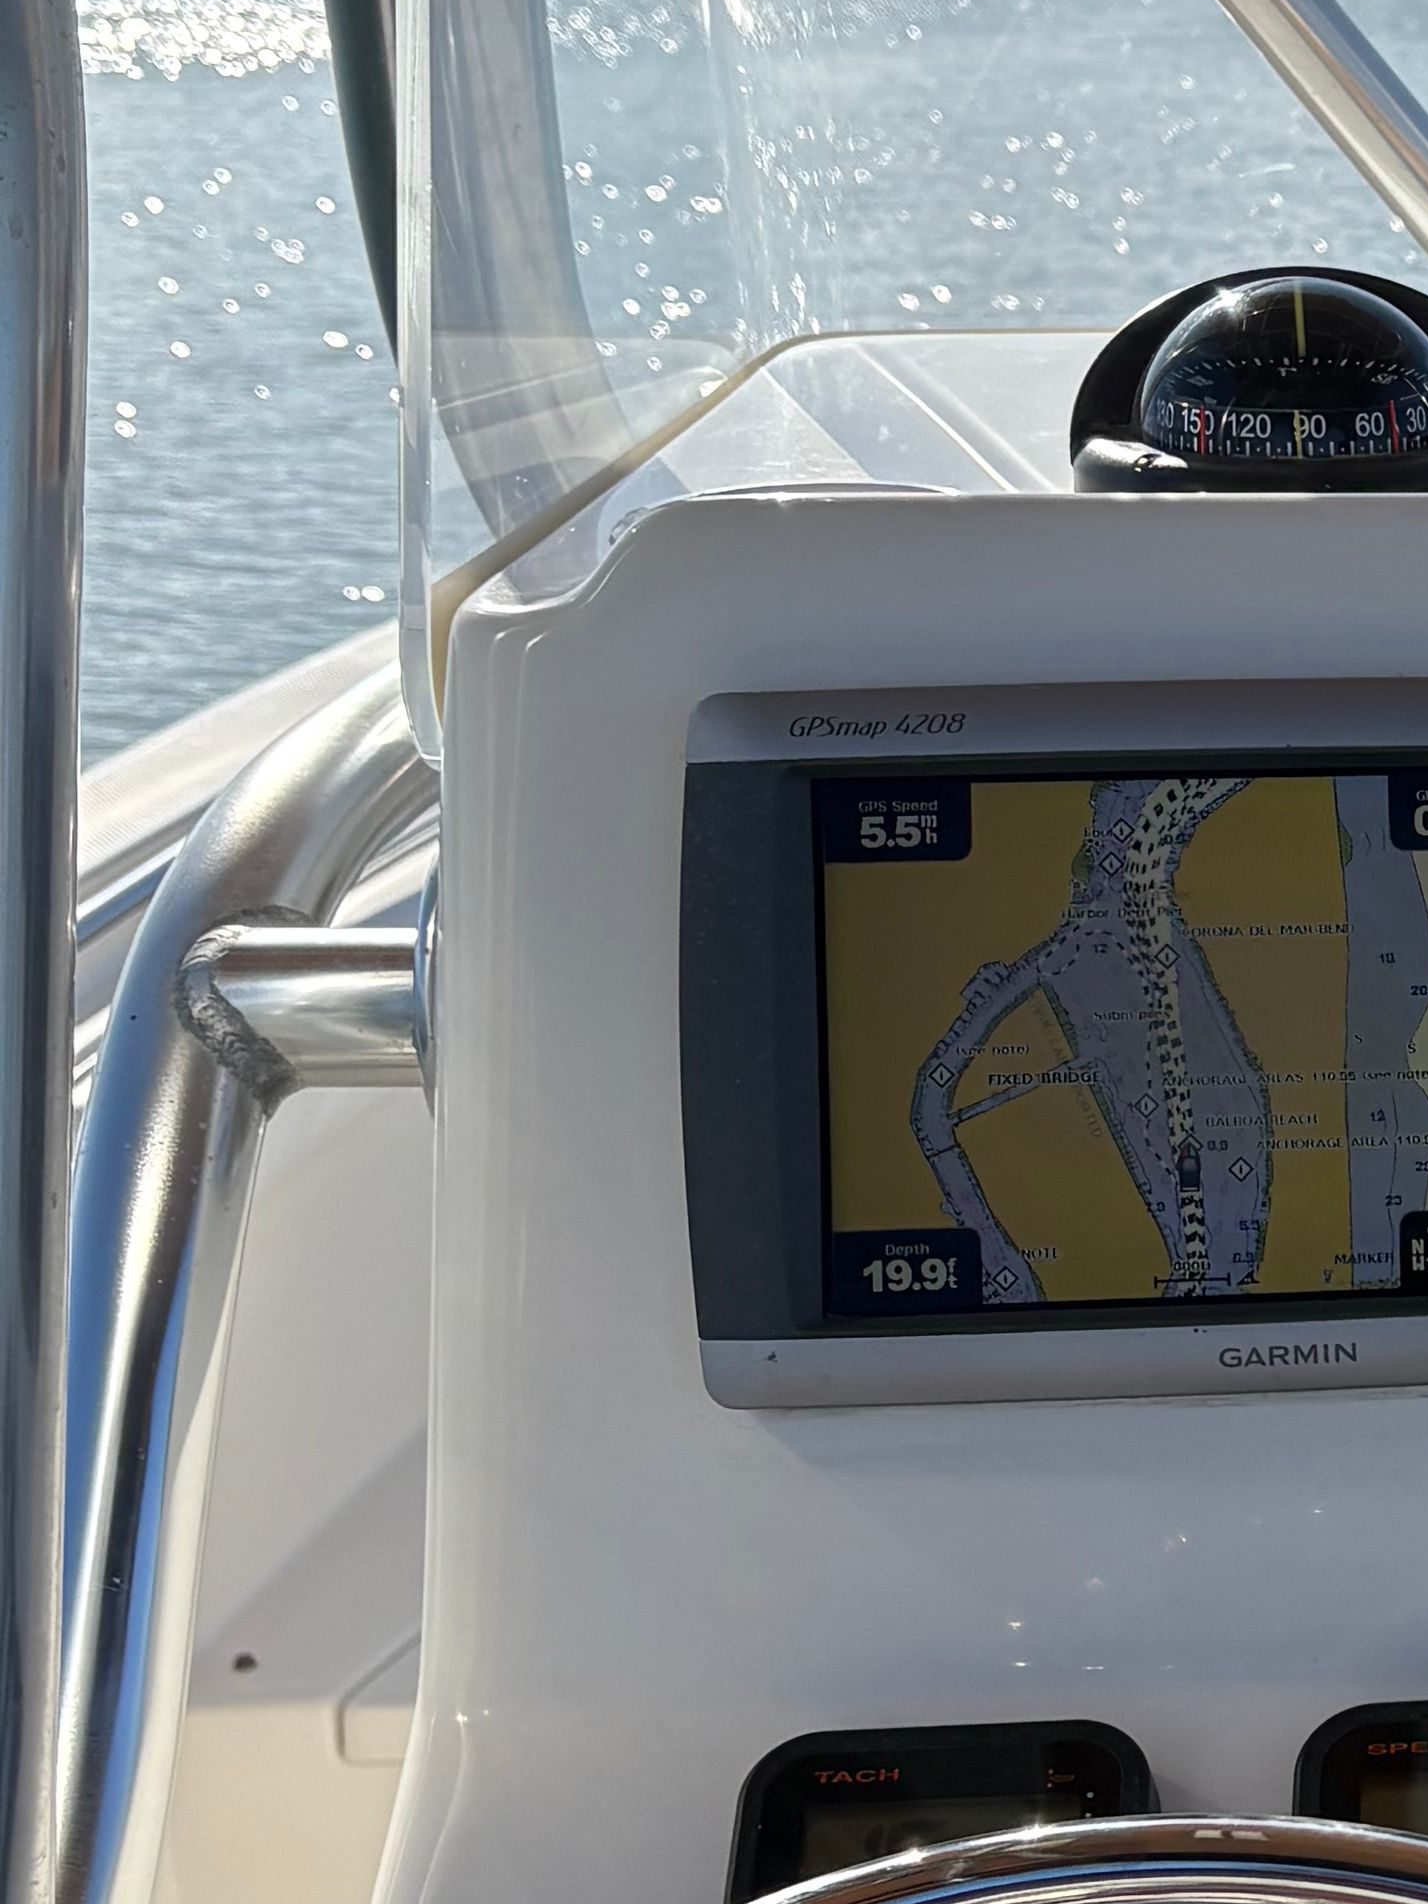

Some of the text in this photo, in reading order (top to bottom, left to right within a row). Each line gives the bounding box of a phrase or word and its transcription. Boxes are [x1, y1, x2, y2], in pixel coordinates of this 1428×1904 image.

[1228, 413, 1272, 438] 120
[1299, 413, 1327, 439] 90
[1355, 411, 1385, 437] 60
[1406, 405, 1427, 432] 30
[790, 713, 966, 739] GPSmap 4208
[858, 800, 938, 813] GPS Speed
[860, 816, 922, 849] 5.5
[988, 1072, 1100, 1086] FIXED BRIDGE
[884, 1243, 930, 1257] Depth
[1411, 1238, 1424, 1254] N
[863, 1257, 948, 1294] 19.9
[1218, 1342, 1358, 1368] GARMIN
[814, 1768, 900, 1784] TACH
